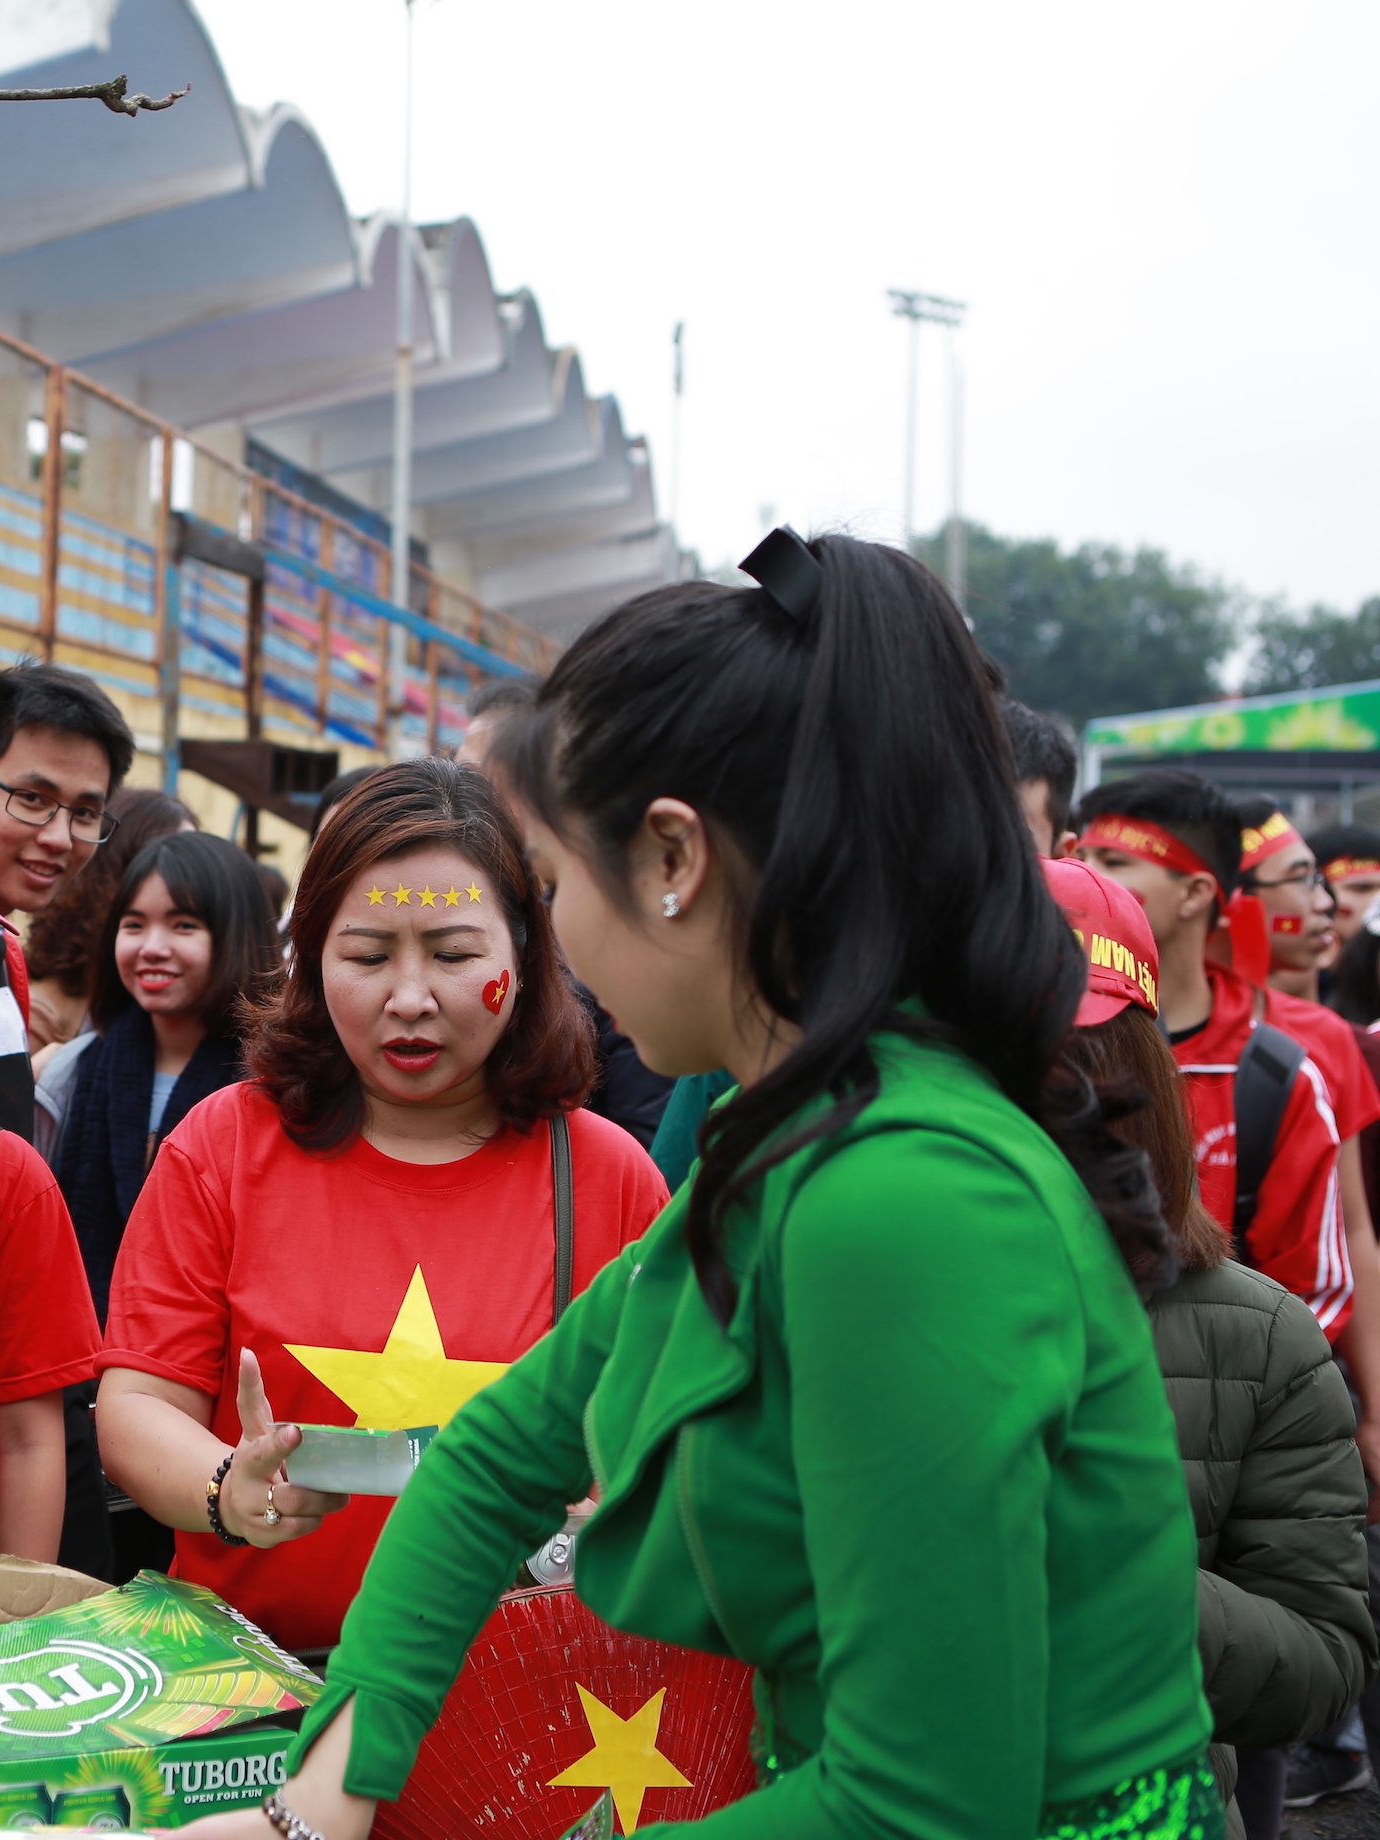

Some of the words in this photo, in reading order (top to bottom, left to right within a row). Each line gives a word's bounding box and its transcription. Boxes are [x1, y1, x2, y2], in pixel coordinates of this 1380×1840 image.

[1090, 933, 1136, 981] NAM
[158, 1750, 288, 1797] TUBORG
[183, 1792, 214, 1805] OPEN
[217, 1790, 239, 1802] FOR
[241, 1788, 263, 1799] FUN
